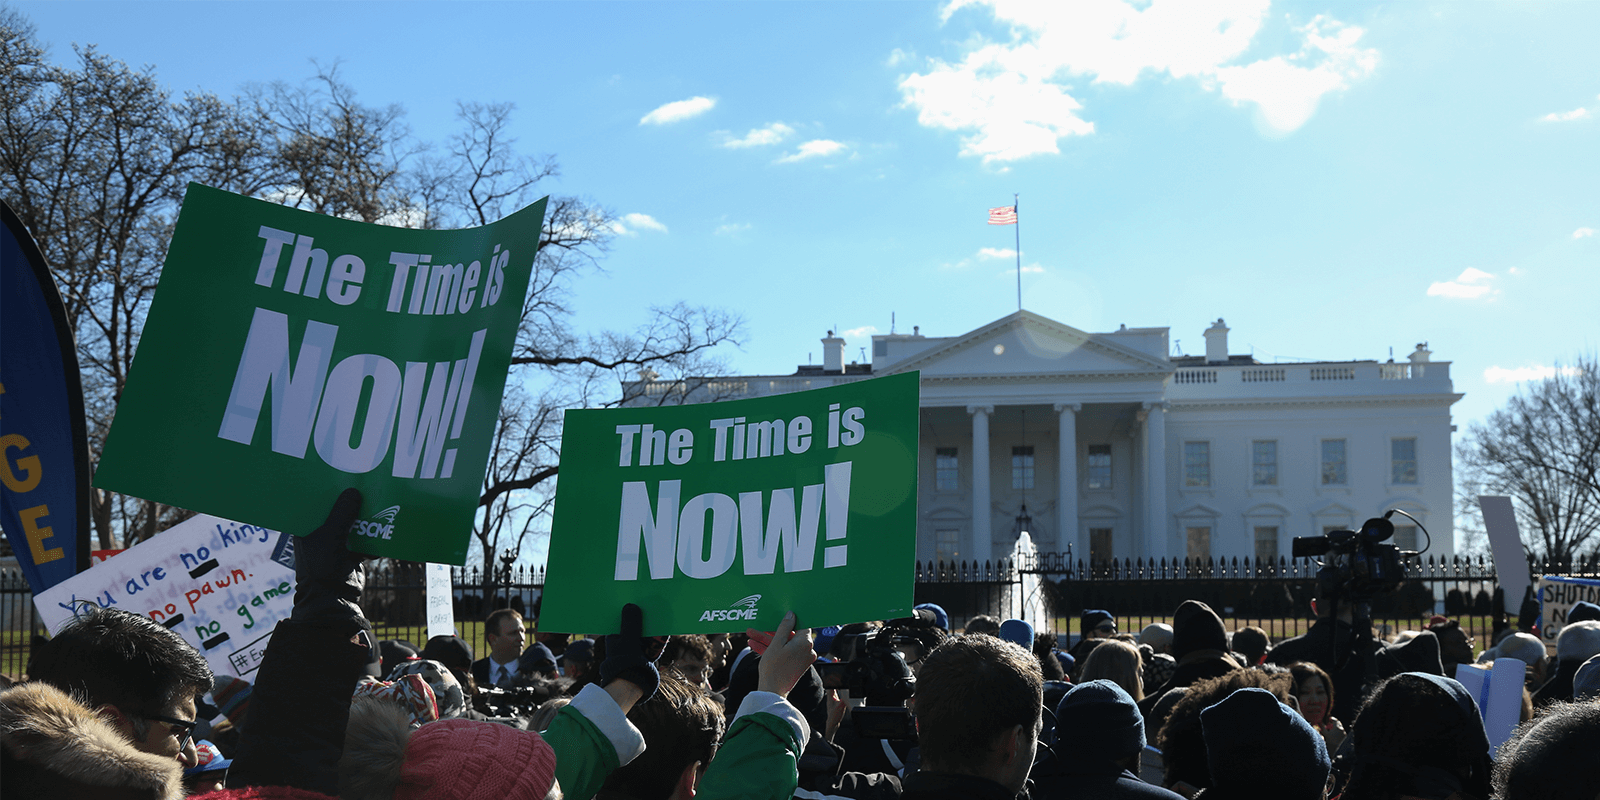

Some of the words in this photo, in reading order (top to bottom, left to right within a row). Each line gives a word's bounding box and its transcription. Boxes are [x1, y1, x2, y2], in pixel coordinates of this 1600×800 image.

[254, 225, 367, 306] The
[386, 251, 482, 315] Time
[480, 243, 510, 309] is
[217, 306, 488, 479] Now!
[615, 423, 694, 467] The
[709, 416, 813, 462] Time
[827, 402, 866, 449] is
[0, 382, 65, 566] GE
[348, 519, 395, 540] FSCME
[614, 460, 853, 581] Now!
[126, 567, 167, 595] are
[180, 546, 210, 570] no
[216, 522, 268, 548] king
[148, 603, 176, 621] no
[184, 568, 254, 614] pawn.
[195, 620, 221, 640] no
[237, 581, 292, 629] game
[699, 608, 759, 622] AFSCME
[1544, 583, 1600, 605] SHUTD
